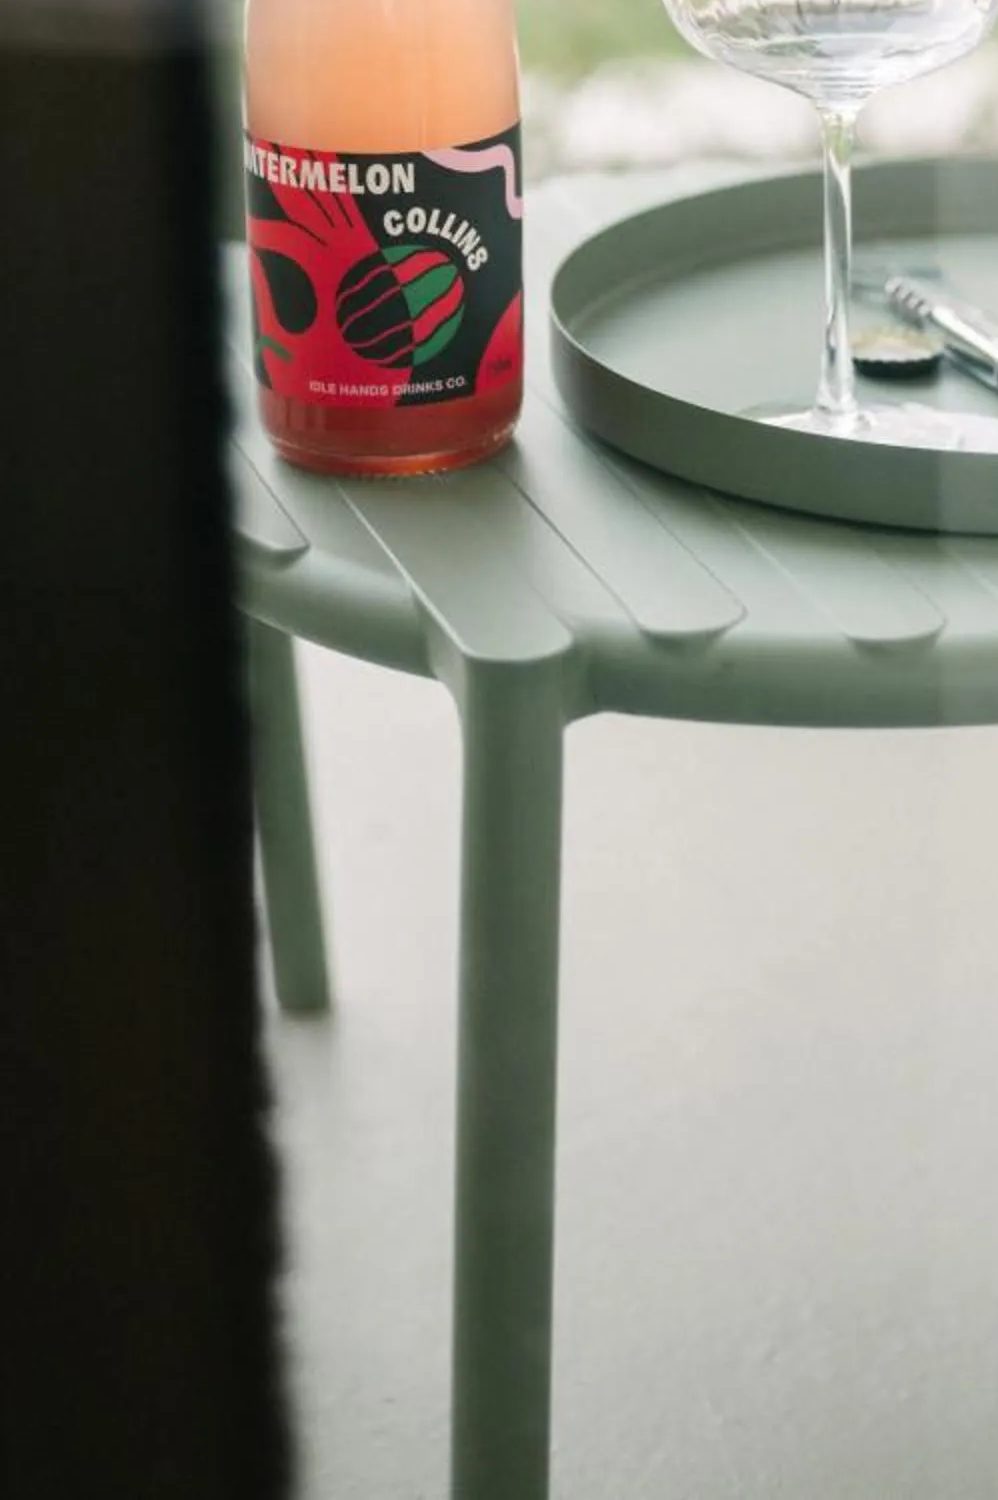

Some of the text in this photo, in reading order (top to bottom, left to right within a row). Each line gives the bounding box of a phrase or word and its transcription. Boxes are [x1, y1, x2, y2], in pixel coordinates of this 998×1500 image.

[243, 141, 414, 194] TERMELON
[383, 206, 488, 271] COLLINS
[309, 380, 336, 395] IDLE
[339, 384, 389, 397] HANDS
[393, 380, 443, 396] DRINKS
